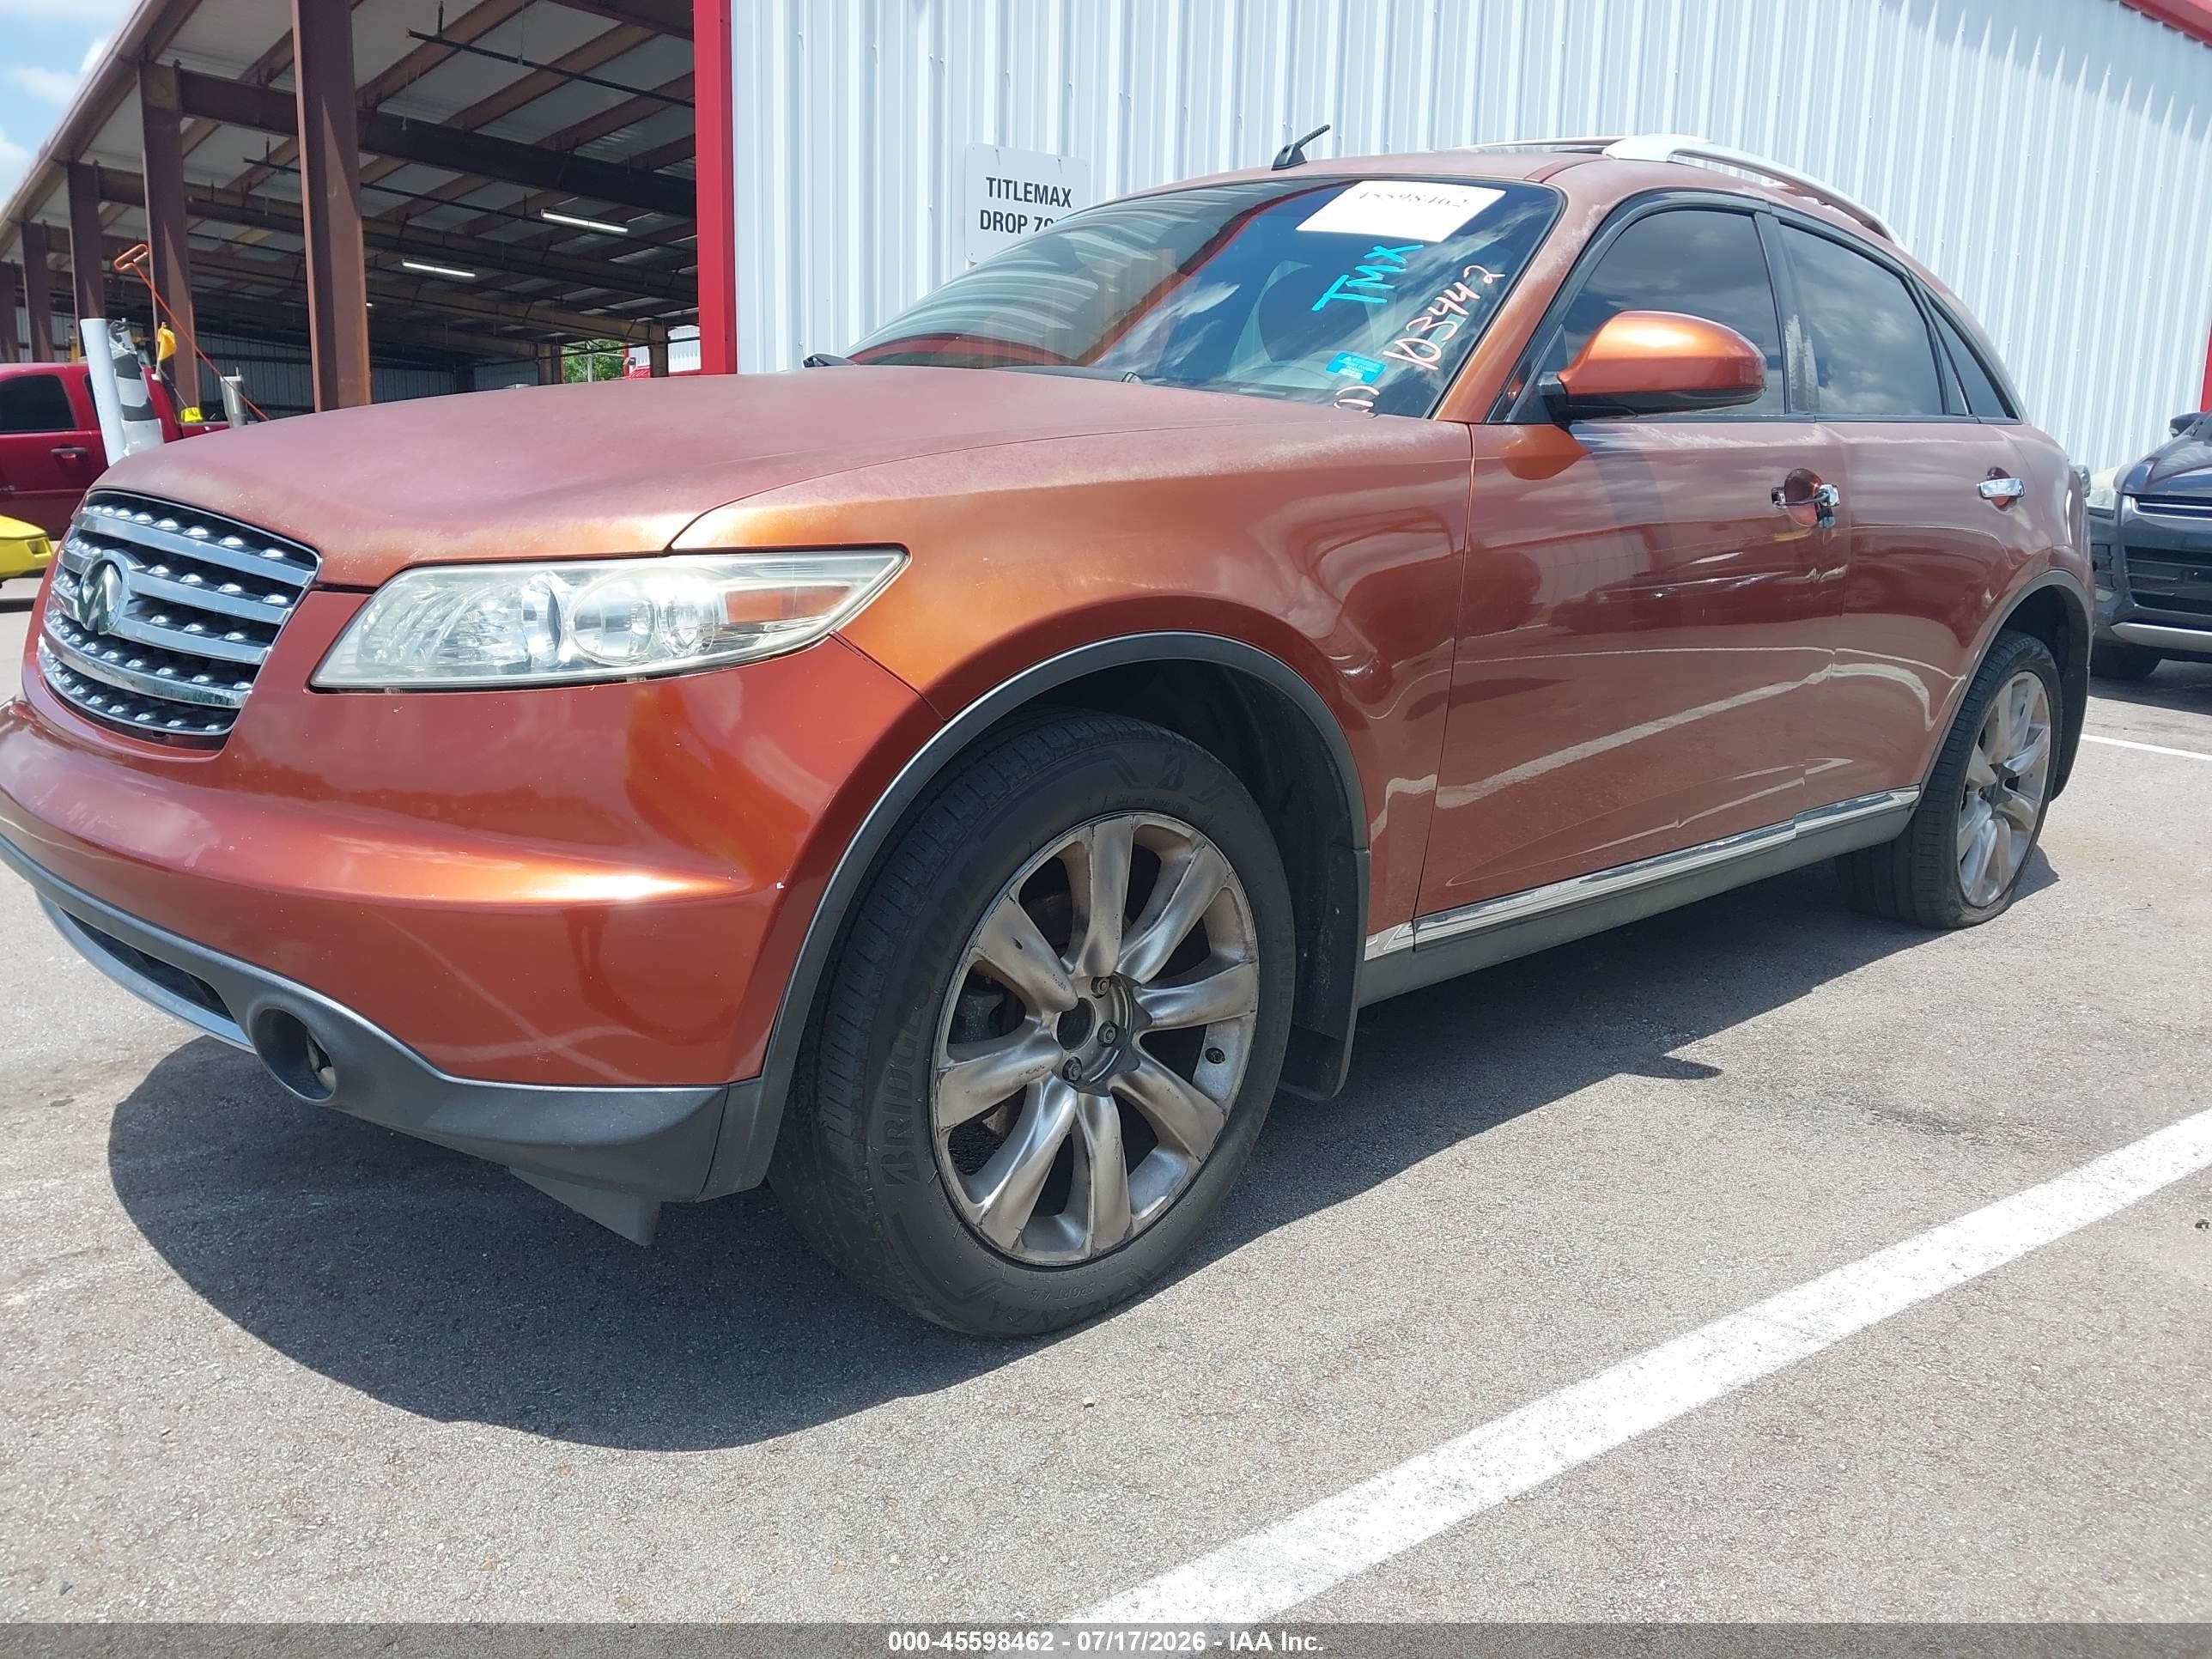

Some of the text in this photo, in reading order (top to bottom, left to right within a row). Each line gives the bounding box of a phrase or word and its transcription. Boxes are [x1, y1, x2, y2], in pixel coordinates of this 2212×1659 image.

[985, 176, 1073, 209] TITLEMAX
[980, 209, 1028, 234] DROP
[1311, 244, 1424, 311] TMX
